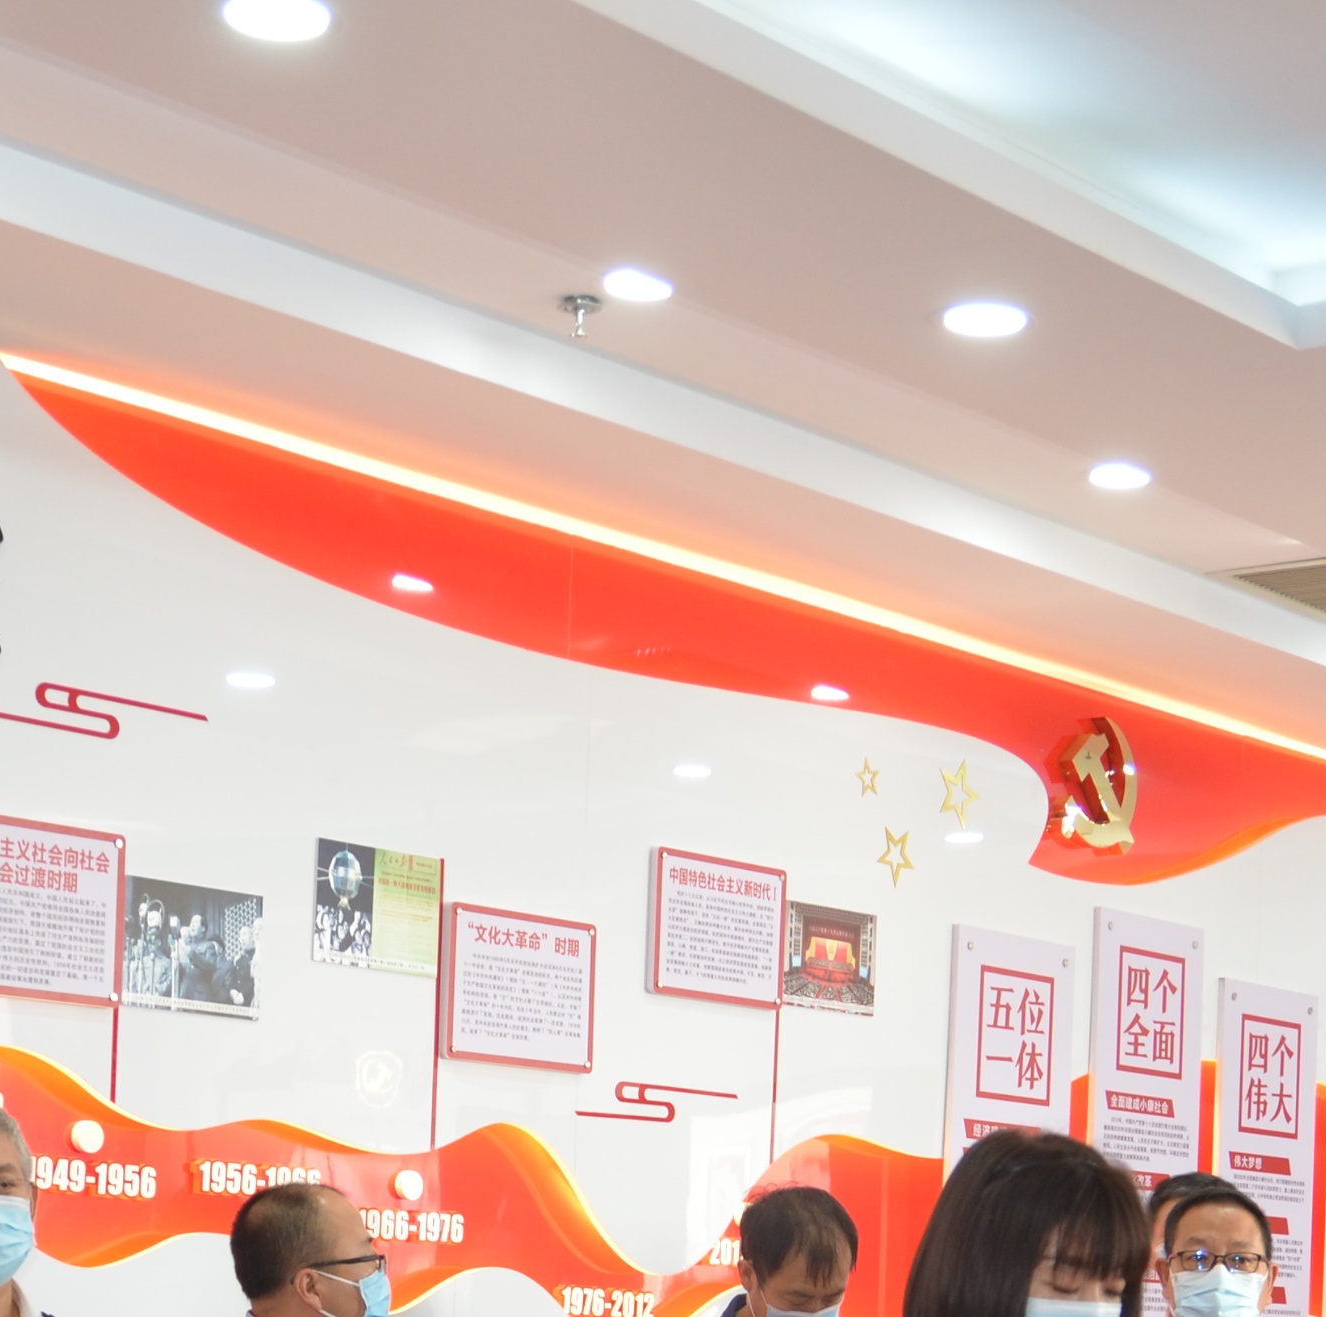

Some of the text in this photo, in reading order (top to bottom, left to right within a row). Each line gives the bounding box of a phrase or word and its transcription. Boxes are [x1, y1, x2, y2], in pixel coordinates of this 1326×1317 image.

[987, 986, 1045, 1036] 五位
[1126, 965, 1178, 1013] 四个
[1124, 1013, 1176, 1065] 全面
[1247, 1032, 1294, 1078] 四个
[985, 1040, 1044, 1090] 一体
[1110, 1094, 1169, 1114] 全面建成小康社会
[1245, 1077, 1292, 1125] 伟大
[1234, 1154, 1263, 1170] 伟大梦想
[709, 1238, 744, 1266] 201
